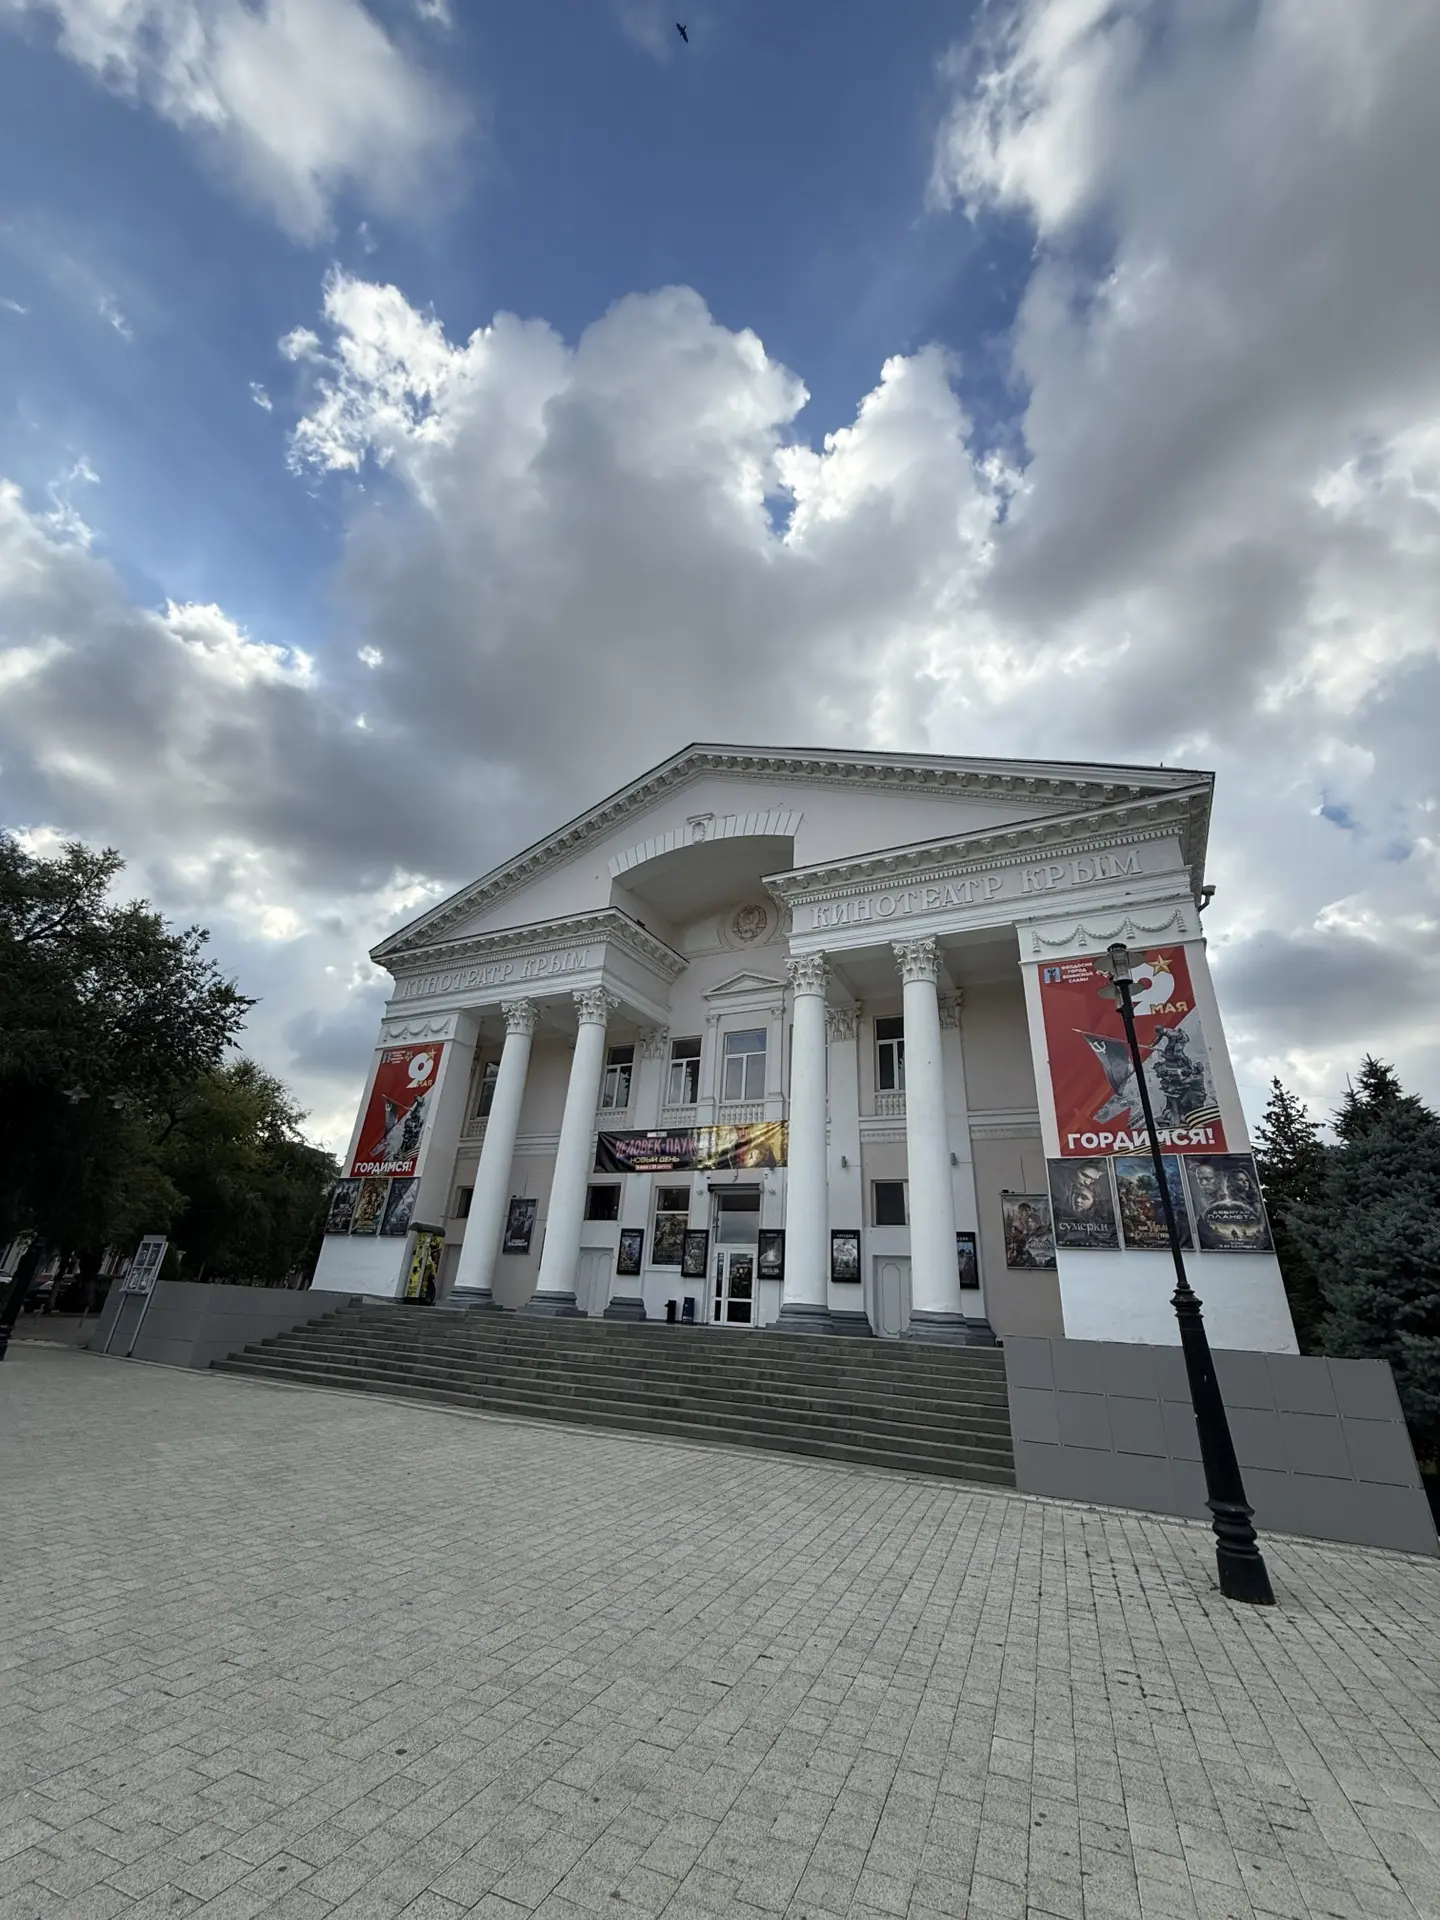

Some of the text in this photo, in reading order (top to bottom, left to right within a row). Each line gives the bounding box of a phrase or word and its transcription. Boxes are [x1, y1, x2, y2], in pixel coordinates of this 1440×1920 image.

[811, 849, 1144, 930] КИНОТЕАТР КРЫМ
[402, 949, 590, 998] КИНОТЕАТР КРЫМ
[1150, 1001, 1188, 1015] МАЯ
[407, 1052, 434, 1089] 9
[615, 1137, 697, 1158] ЧЕЛОВЕК-ПАУК
[354, 1161, 413, 1174] ГОРДИМСЯ!
[630, 1155, 680, 1164] НОВЫЙ ДЕНЬ
